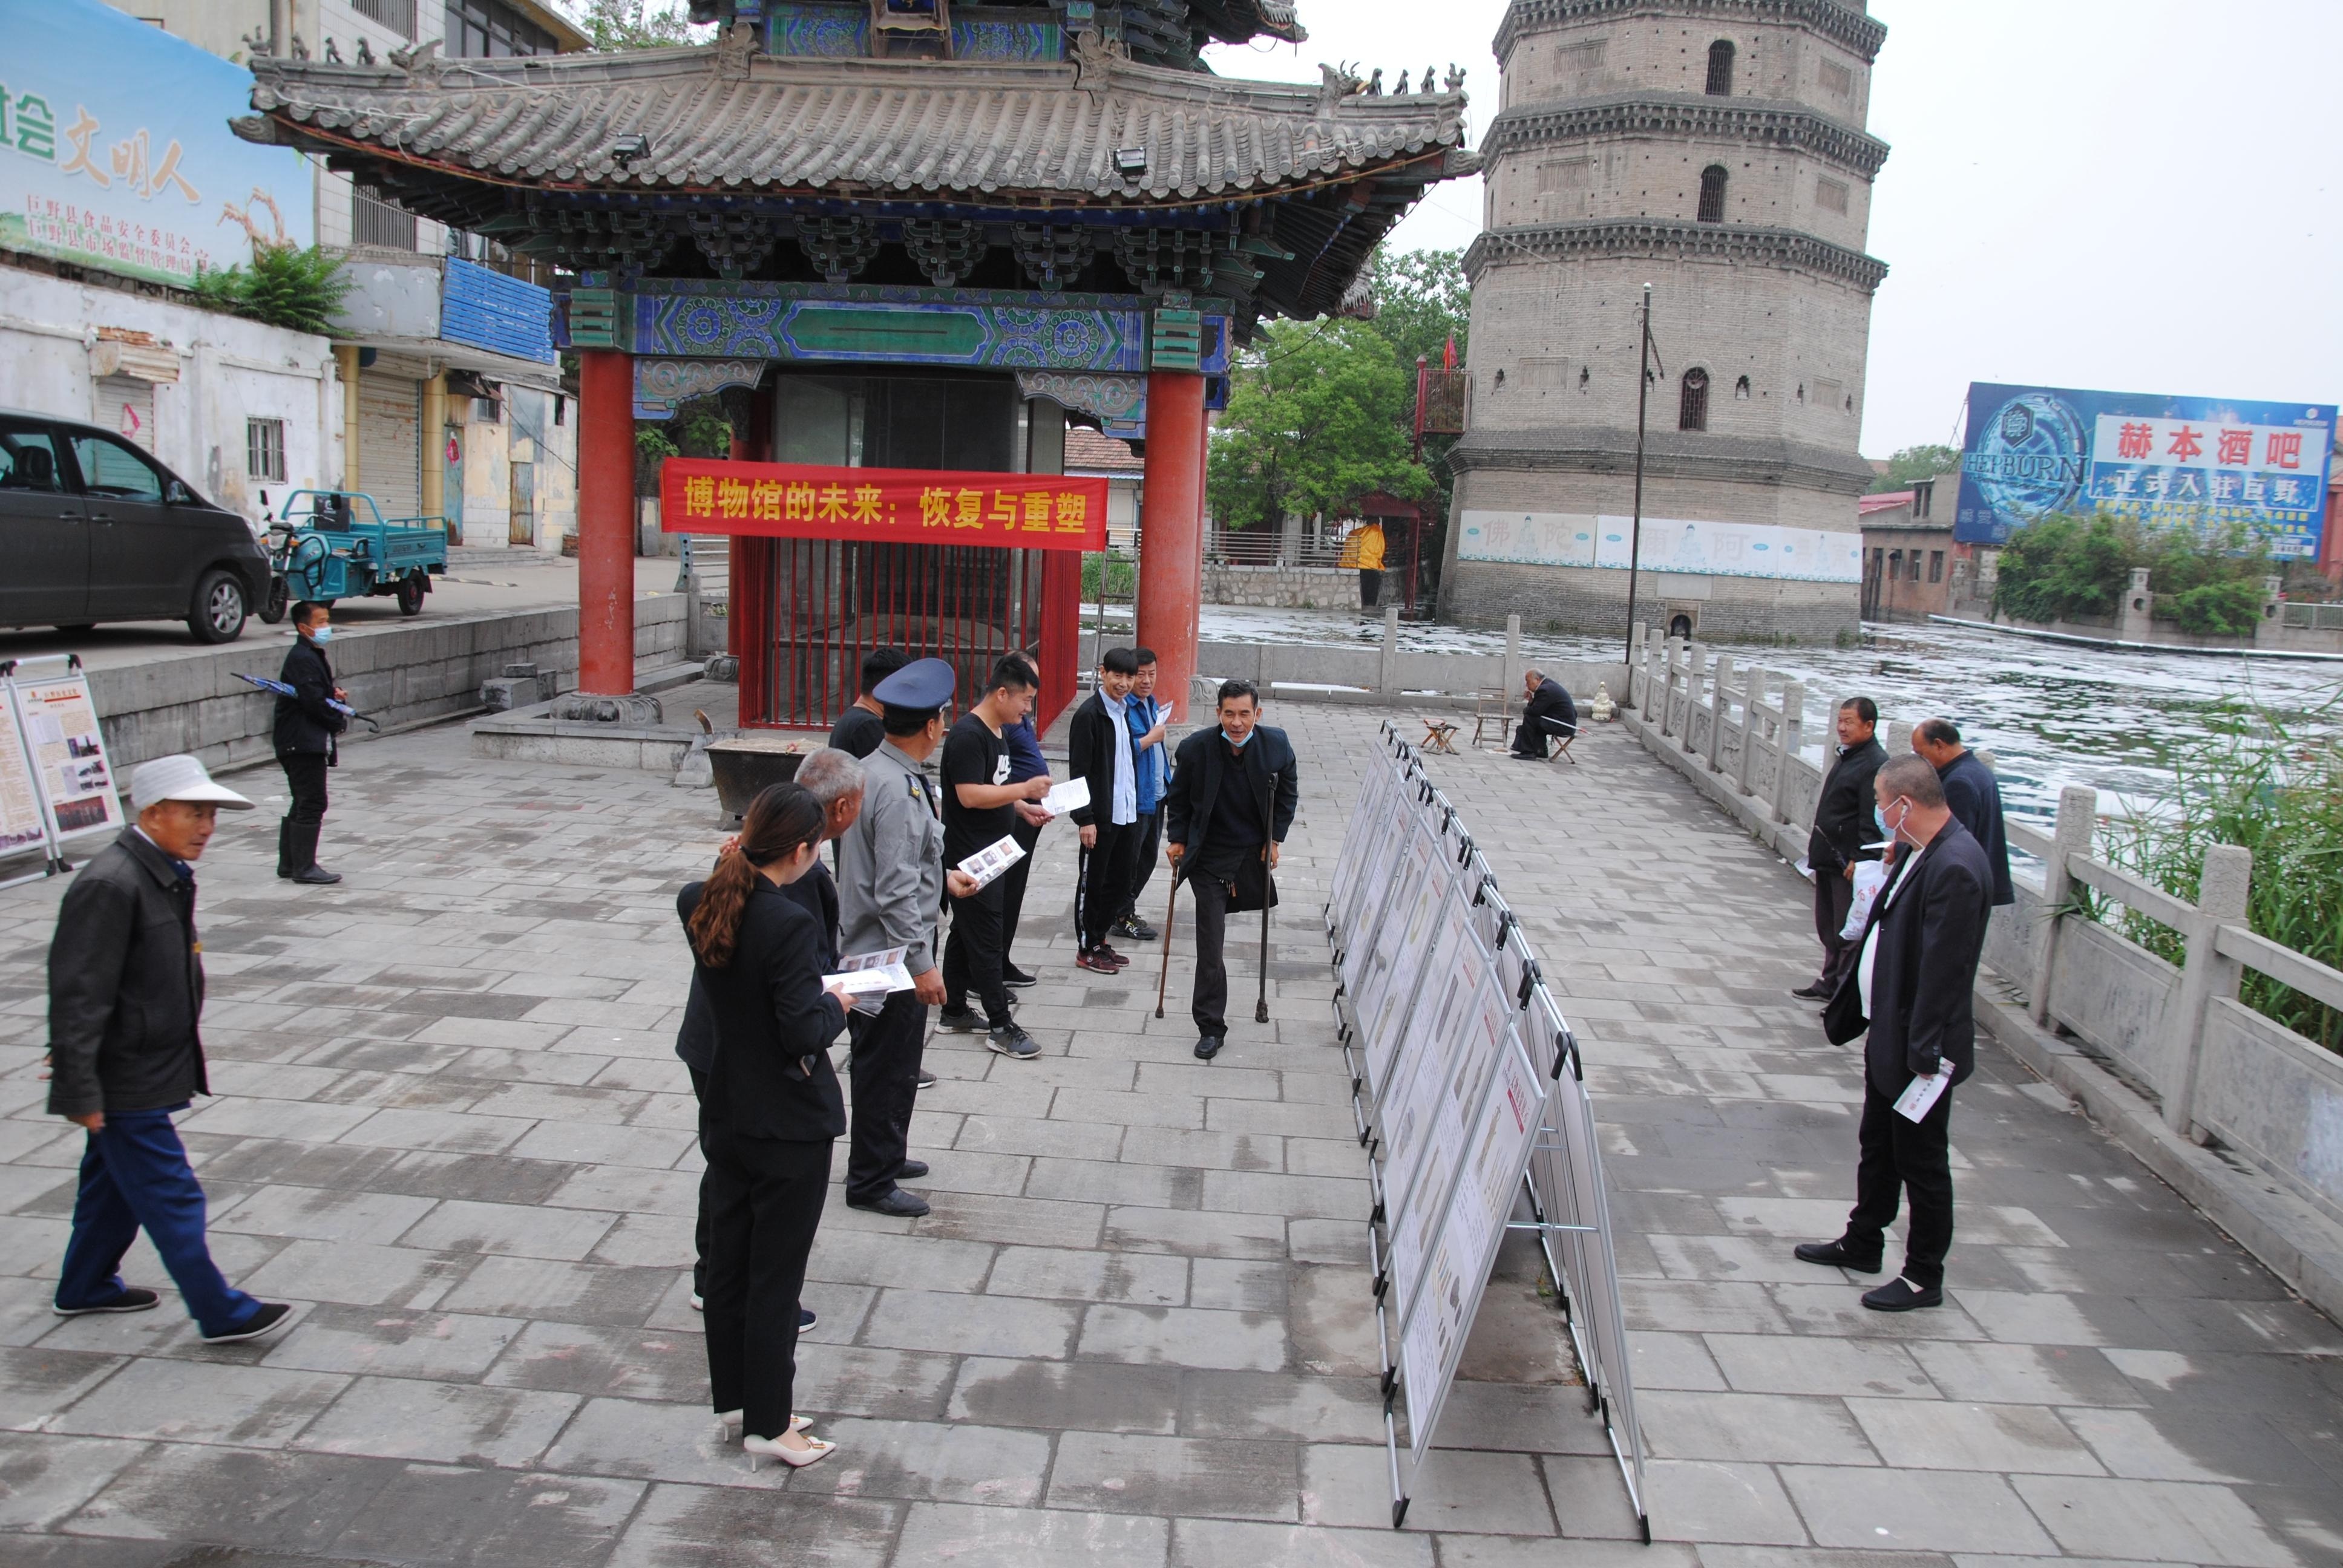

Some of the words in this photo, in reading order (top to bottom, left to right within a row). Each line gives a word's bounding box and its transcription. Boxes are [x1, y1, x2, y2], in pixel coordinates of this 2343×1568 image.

[27, 194, 190, 255] 巨野县食品安全委员会
[29, 218, 191, 276] 巨野县市场监督管理局
[1966, 454, 2089, 485] HEPBURN
[2119, 422, 2303, 469] 赫本酒吧
[684, 476, 1086, 533] 博物馆的未来：恢复与重塑
[2114, 469, 2299, 504] 正式入驻巨野
